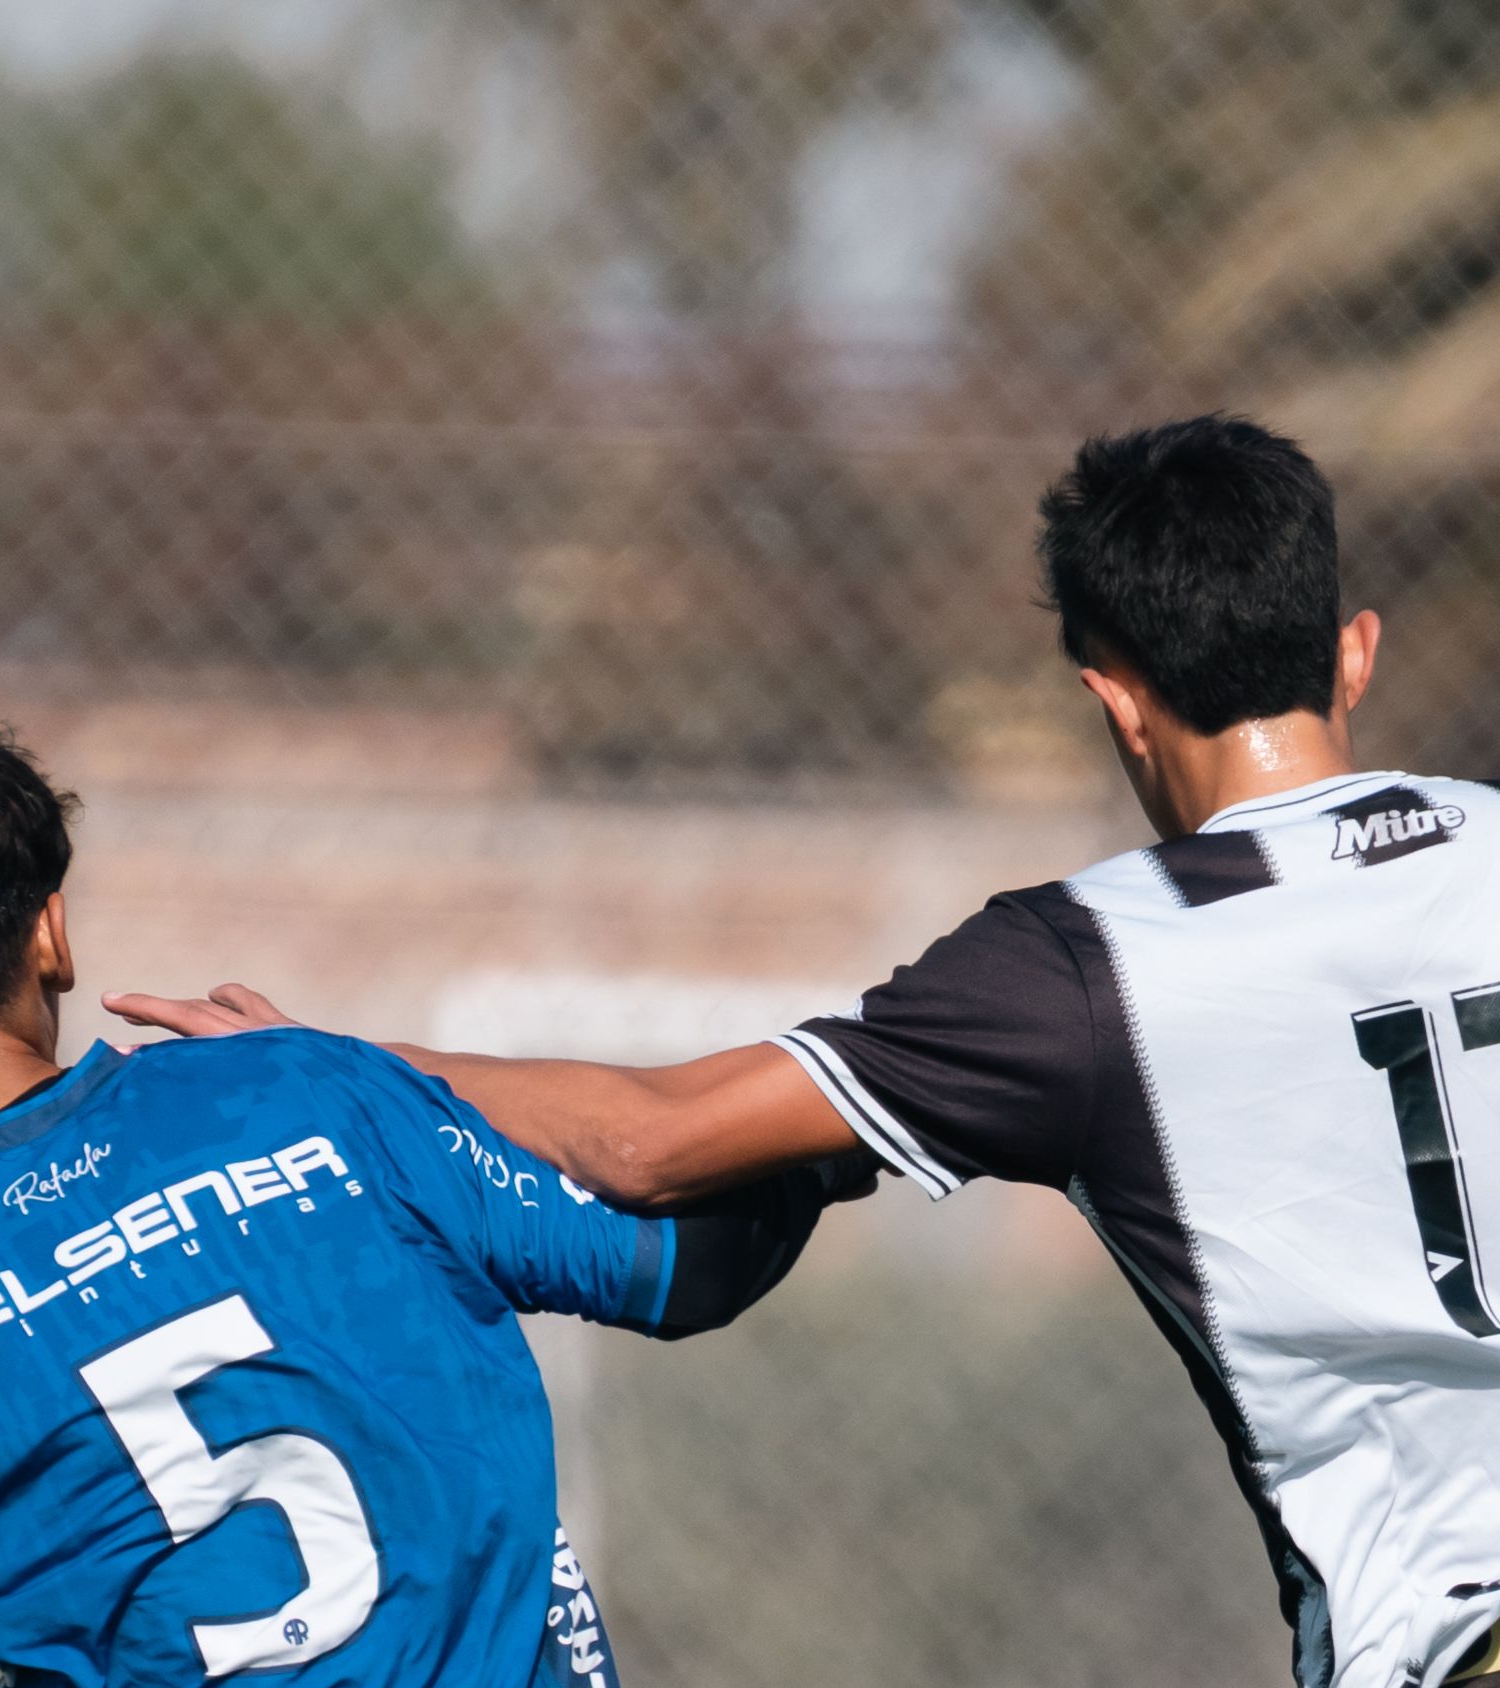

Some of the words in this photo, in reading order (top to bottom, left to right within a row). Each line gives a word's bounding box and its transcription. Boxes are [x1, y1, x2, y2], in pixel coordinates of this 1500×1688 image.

[1332, 805, 1465, 860] Mitre
[3, 1143, 111, 1215] Rafaela
[78, 1292, 382, 1678] 5
